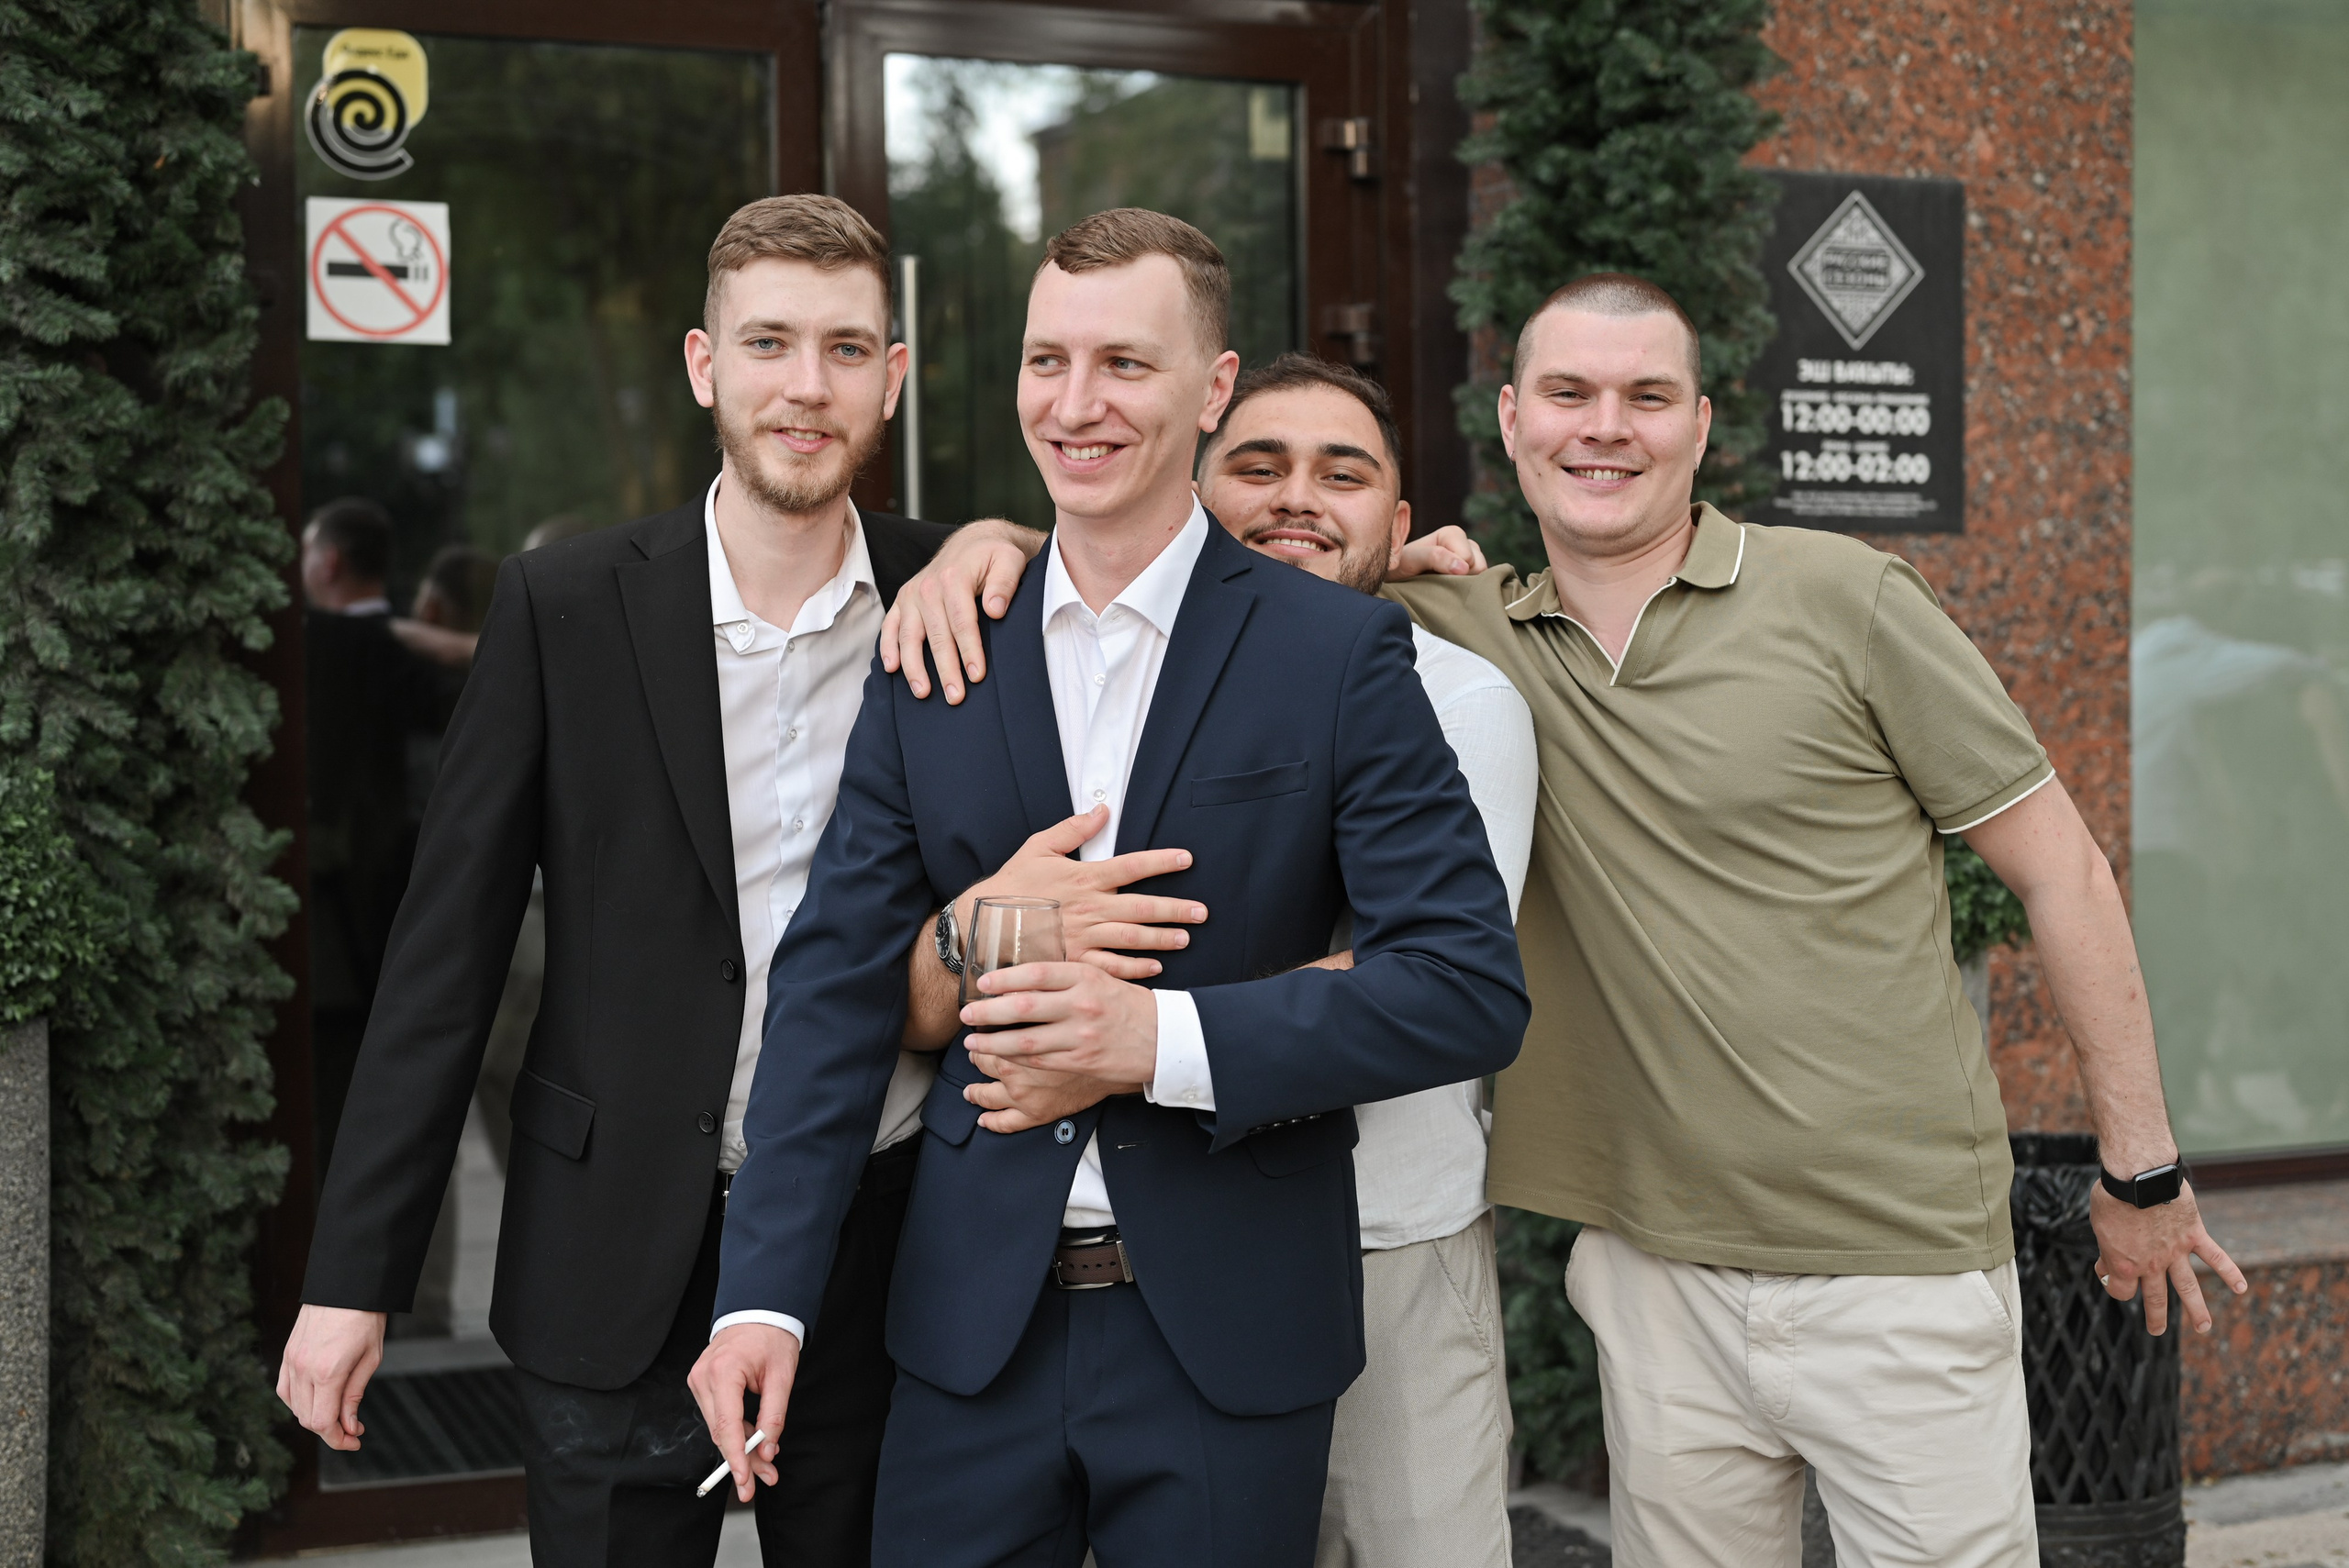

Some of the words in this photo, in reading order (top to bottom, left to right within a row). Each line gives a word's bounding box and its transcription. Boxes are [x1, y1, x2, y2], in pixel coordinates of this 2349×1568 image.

[1797, 358, 1831, 384] ЭШ
[1781, 402, 1932, 436] 12:00-00:00
[1780, 450, 1932, 484] 12:00-02:00
